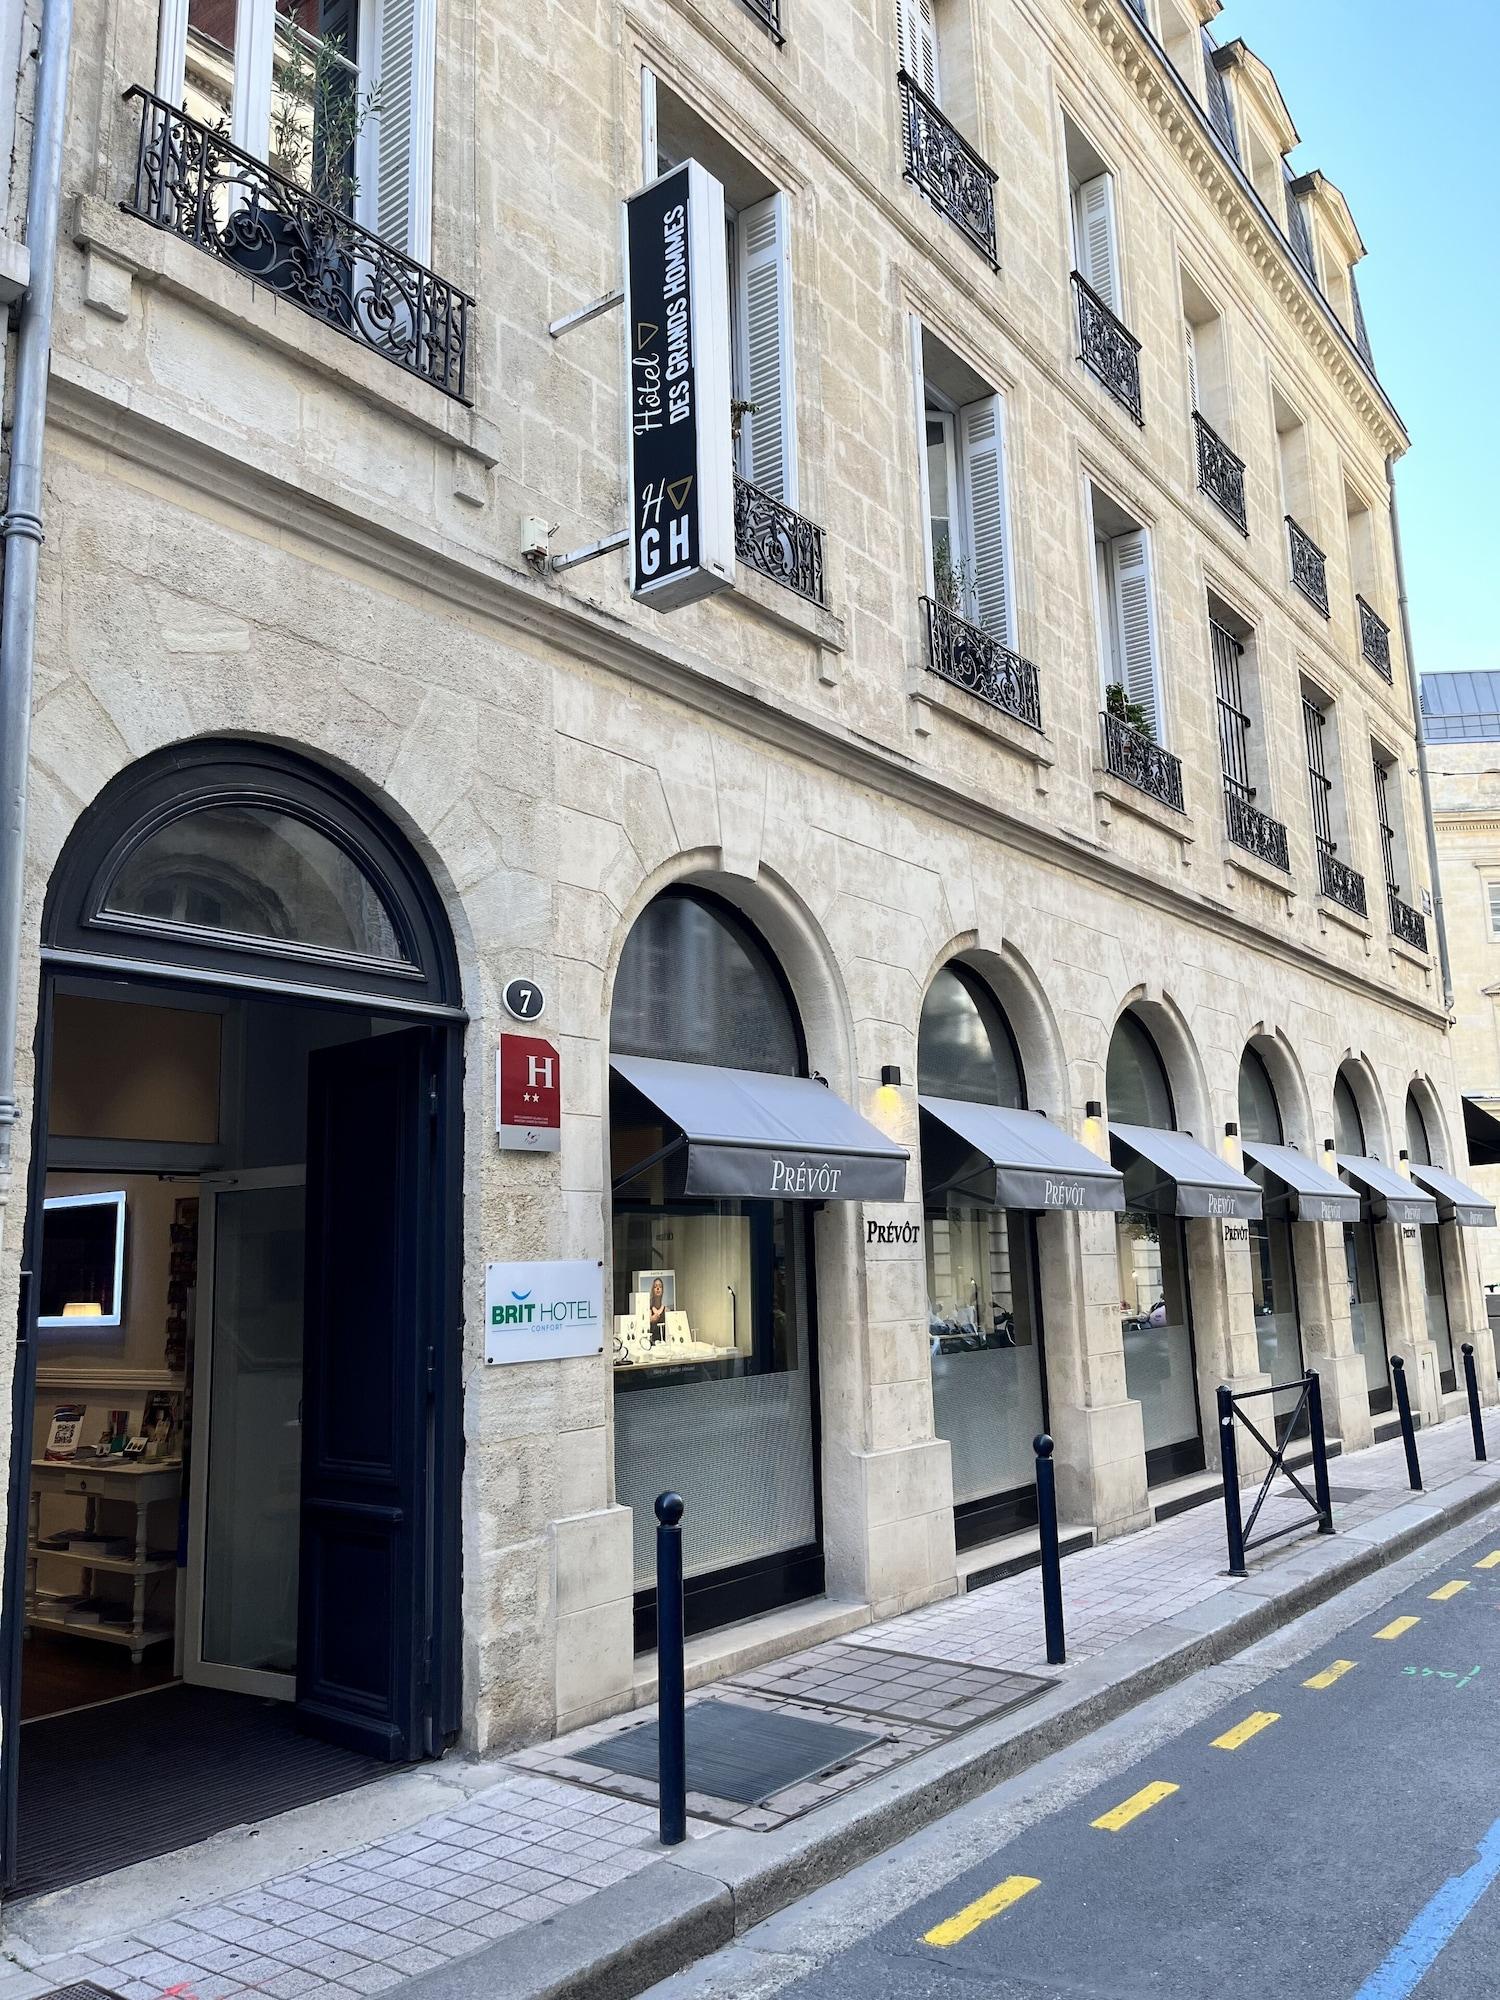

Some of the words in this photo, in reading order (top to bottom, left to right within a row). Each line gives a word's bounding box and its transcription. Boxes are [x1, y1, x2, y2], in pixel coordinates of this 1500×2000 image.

[663, 204, 687, 300] HOMMES
[665, 297, 690, 381] GRANDS
[632, 353, 663, 436] Hôtel
[668, 380, 691, 425] DES
[520, 989, 532, 1014] 7
[526, 1054, 554, 1089] H
[769, 1160, 842, 1193] PRÉVÔT
[1044, 1179, 1086, 1206] PRÉVÔT
[866, 1219, 920, 1244] PRÉVÔT
[491, 1303, 536, 1325] BRIT
[540, 1301, 597, 1321] HOTEL
[531, 1323, 563, 1333] CONFORT
